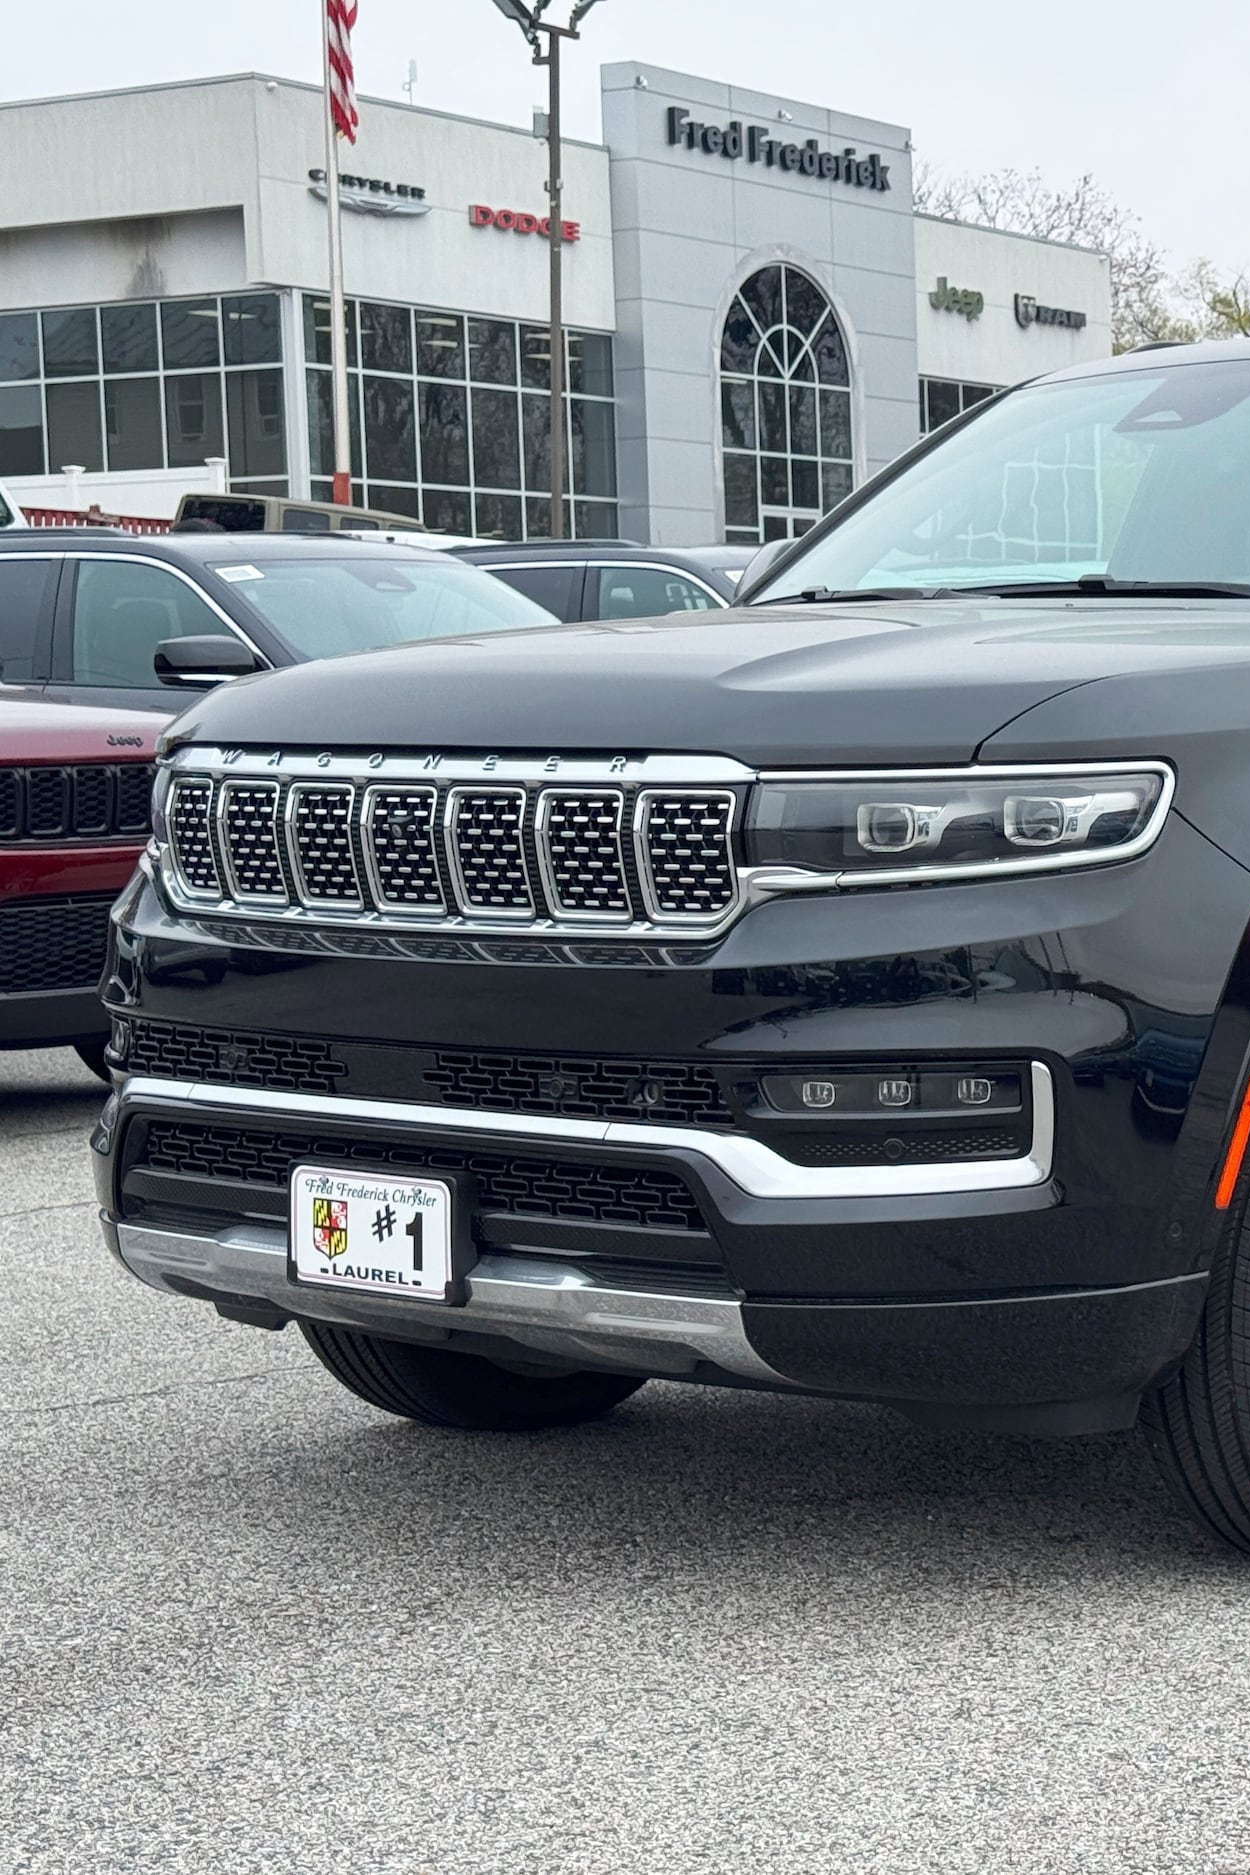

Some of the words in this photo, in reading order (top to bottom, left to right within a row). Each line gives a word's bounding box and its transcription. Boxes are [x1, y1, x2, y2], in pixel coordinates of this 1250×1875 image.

[667, 106, 742, 159] Fred
[748, 125, 891, 191] Frederick
[928, 276, 984, 322] Jeep
[1035, 305, 1087, 329] RAM
[220, 749, 628, 773] WAGONEER
[305, 1178, 333, 1195] Fred
[336, 1183, 389, 1202] Frederick
[392, 1188, 438, 1208] Chrysler
